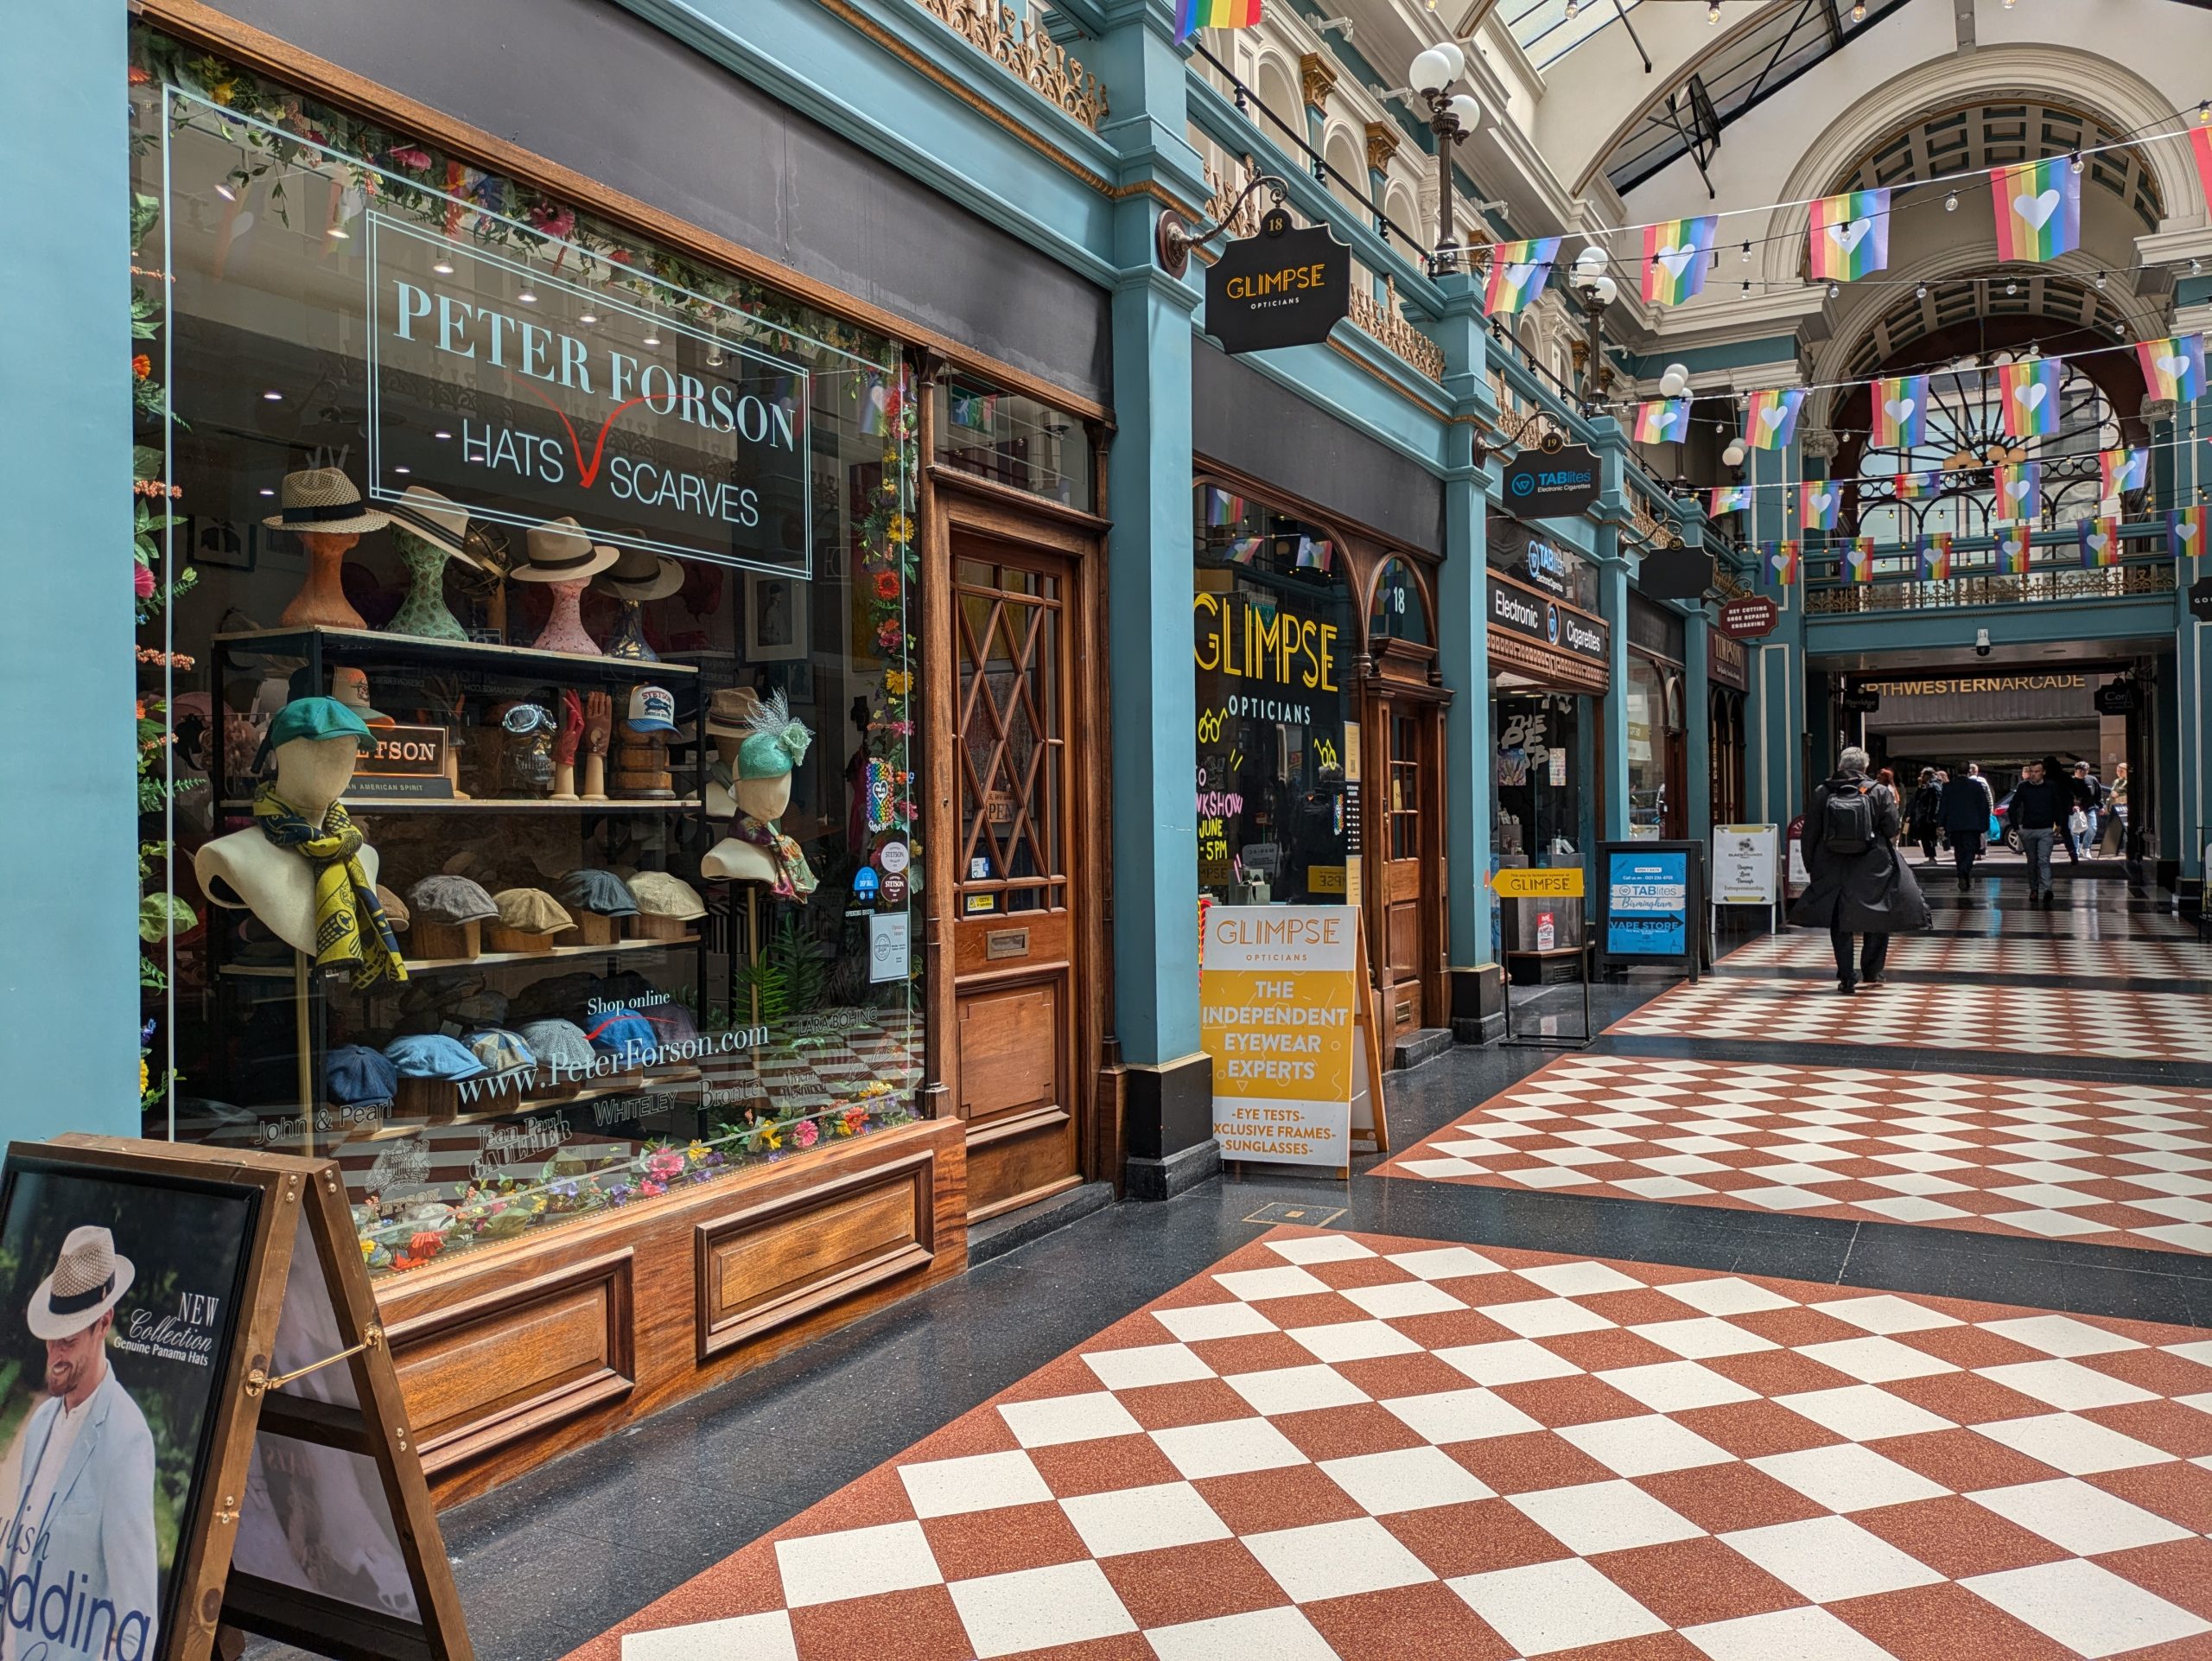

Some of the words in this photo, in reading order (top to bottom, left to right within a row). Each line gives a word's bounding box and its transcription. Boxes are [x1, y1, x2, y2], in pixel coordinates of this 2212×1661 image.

[1268, 218, 1283, 232] 18
[1227, 264, 1325, 299] GLIMPSE
[1250, 297, 1300, 309] OPTICIANS
[392, 279, 594, 394] PETER
[607, 350, 796, 452] FORSON
[1547, 438, 1557, 447] 19
[463, 418, 564, 483] HATS
[610, 457, 759, 527] SCARVES
[1538, 471, 1591, 486] TABlites
[1393, 586, 1405, 614] 18
[1496, 589, 1538, 629] Electronic
[1567, 619, 1600, 652] Cigarettes
[1731, 620, 1765, 629] ENGRAVING
[1194, 593, 1338, 692] GLIMPSE
[1714, 633, 1742, 667] TIMPSON
[1228, 695, 1311, 725] OPTICIANS
[1508, 714, 1546, 729] THE
[988, 803, 1013, 820] PEN
[1198, 818, 1223, 838] JUNE
[1510, 878, 1570, 891] GLIMPSE
[1632, 886, 1677, 896] TABlites
[1622, 897, 1673, 910] Birmingham
[1217, 919, 1340, 945] GLIMPSE
[1610, 921, 1640, 930] VAPE
[1642, 921, 1679, 930] STORE
[1255, 981, 1294, 998] THE
[588, 998, 624, 1015] Shop
[628, 990, 671, 1009] online
[798, 1015, 830, 1036] LARA
[832, 1007, 878, 1029] BOHINC
[1203, 1006, 1348, 1026] INDEPENDENT
[1224, 1033, 1321, 1053] EYEWEAR
[456, 1024, 769, 1105] www.PeterForson.com
[1228, 1060, 1315, 1079] EXPERTS
[785, 1070, 822, 1085] Vivienne
[781, 1082, 827, 1099] Westwood
[594, 1090, 678, 1127] WHITELEY
[254, 1118, 308, 1146] John
[315, 1109, 334, 1133] &
[340, 1097, 393, 1129] Pearl
[477, 1127, 518, 1154] Jean
[524, 1110, 562, 1135] Paul
[1214, 1123, 1274, 1137] XCLUSIVE
[469, 1120, 572, 1180] GAULTIER
[177, 1292, 219, 1327] NEW
[129, 1308, 213, 1352] Collection
[113, 1336, 150, 1354] Genuine
[151, 1344, 187, 1363] Panama
[188, 1351, 209, 1366] Hats
